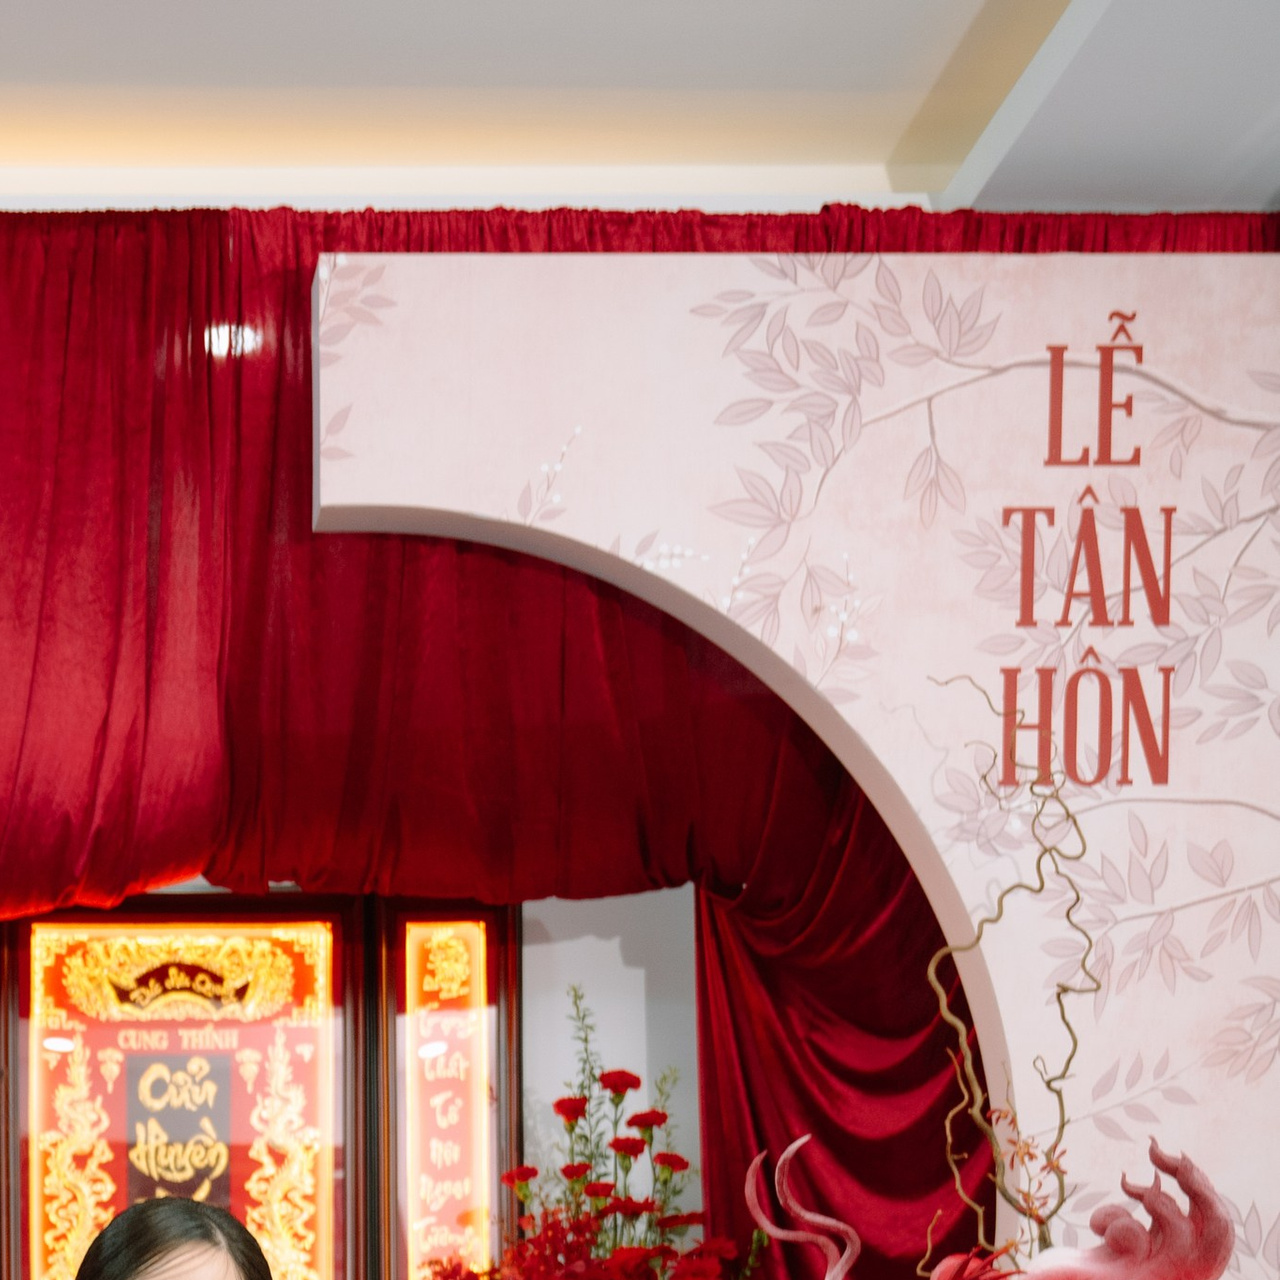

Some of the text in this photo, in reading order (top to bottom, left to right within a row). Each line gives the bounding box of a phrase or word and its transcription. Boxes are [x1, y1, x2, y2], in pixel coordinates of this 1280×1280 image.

[1044, 310, 1144, 467] LỄ
[1002, 485, 1177, 627] TÂN
[997, 646, 1175, 787] HÔN
[117, 1028, 169, 1050] CUNG
[128, 1116, 230, 1183] Huyền
